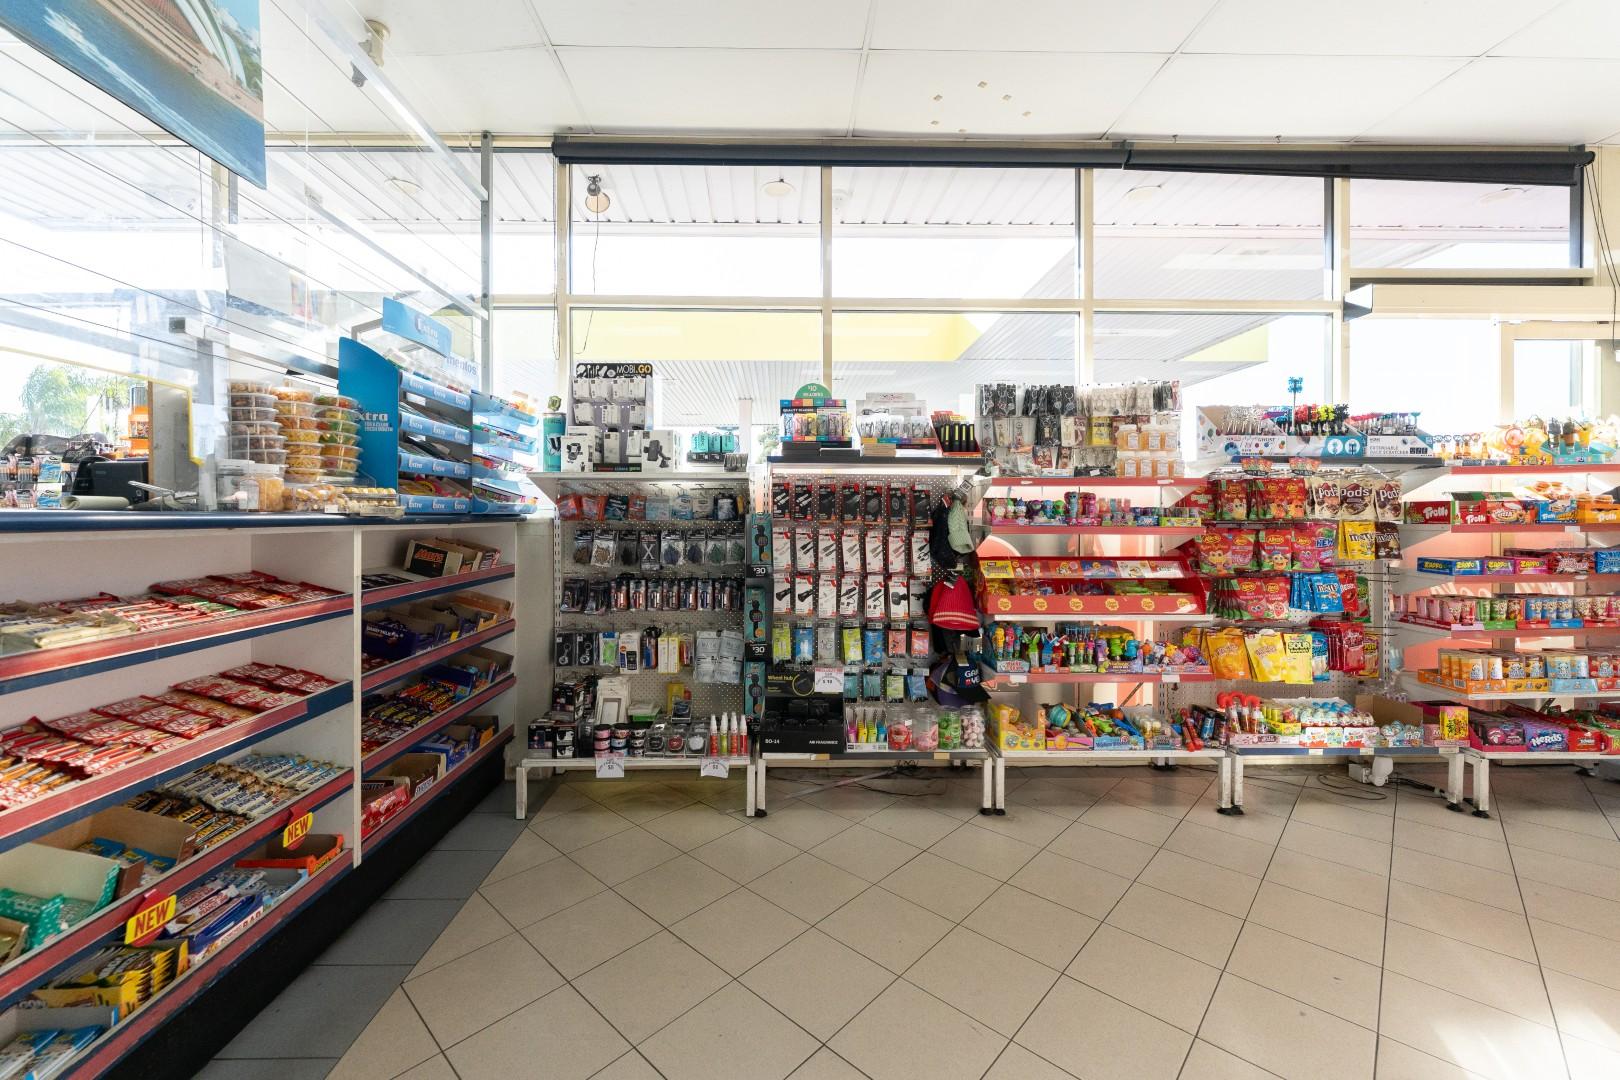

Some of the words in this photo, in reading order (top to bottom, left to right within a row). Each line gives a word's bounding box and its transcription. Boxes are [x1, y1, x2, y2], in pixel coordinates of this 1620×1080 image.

[446, 356, 477, 375] mentos
[1423, 506, 1448, 518] Trolli
[1466, 513, 1486, 523] Trolli
[1316, 538, 1334, 548] NEW
[752, 646, 765, 654] $30
[1288, 641, 1311, 649] SOUR
[287, 819, 309, 843] NEW
[134, 900, 171, 938] NEW
